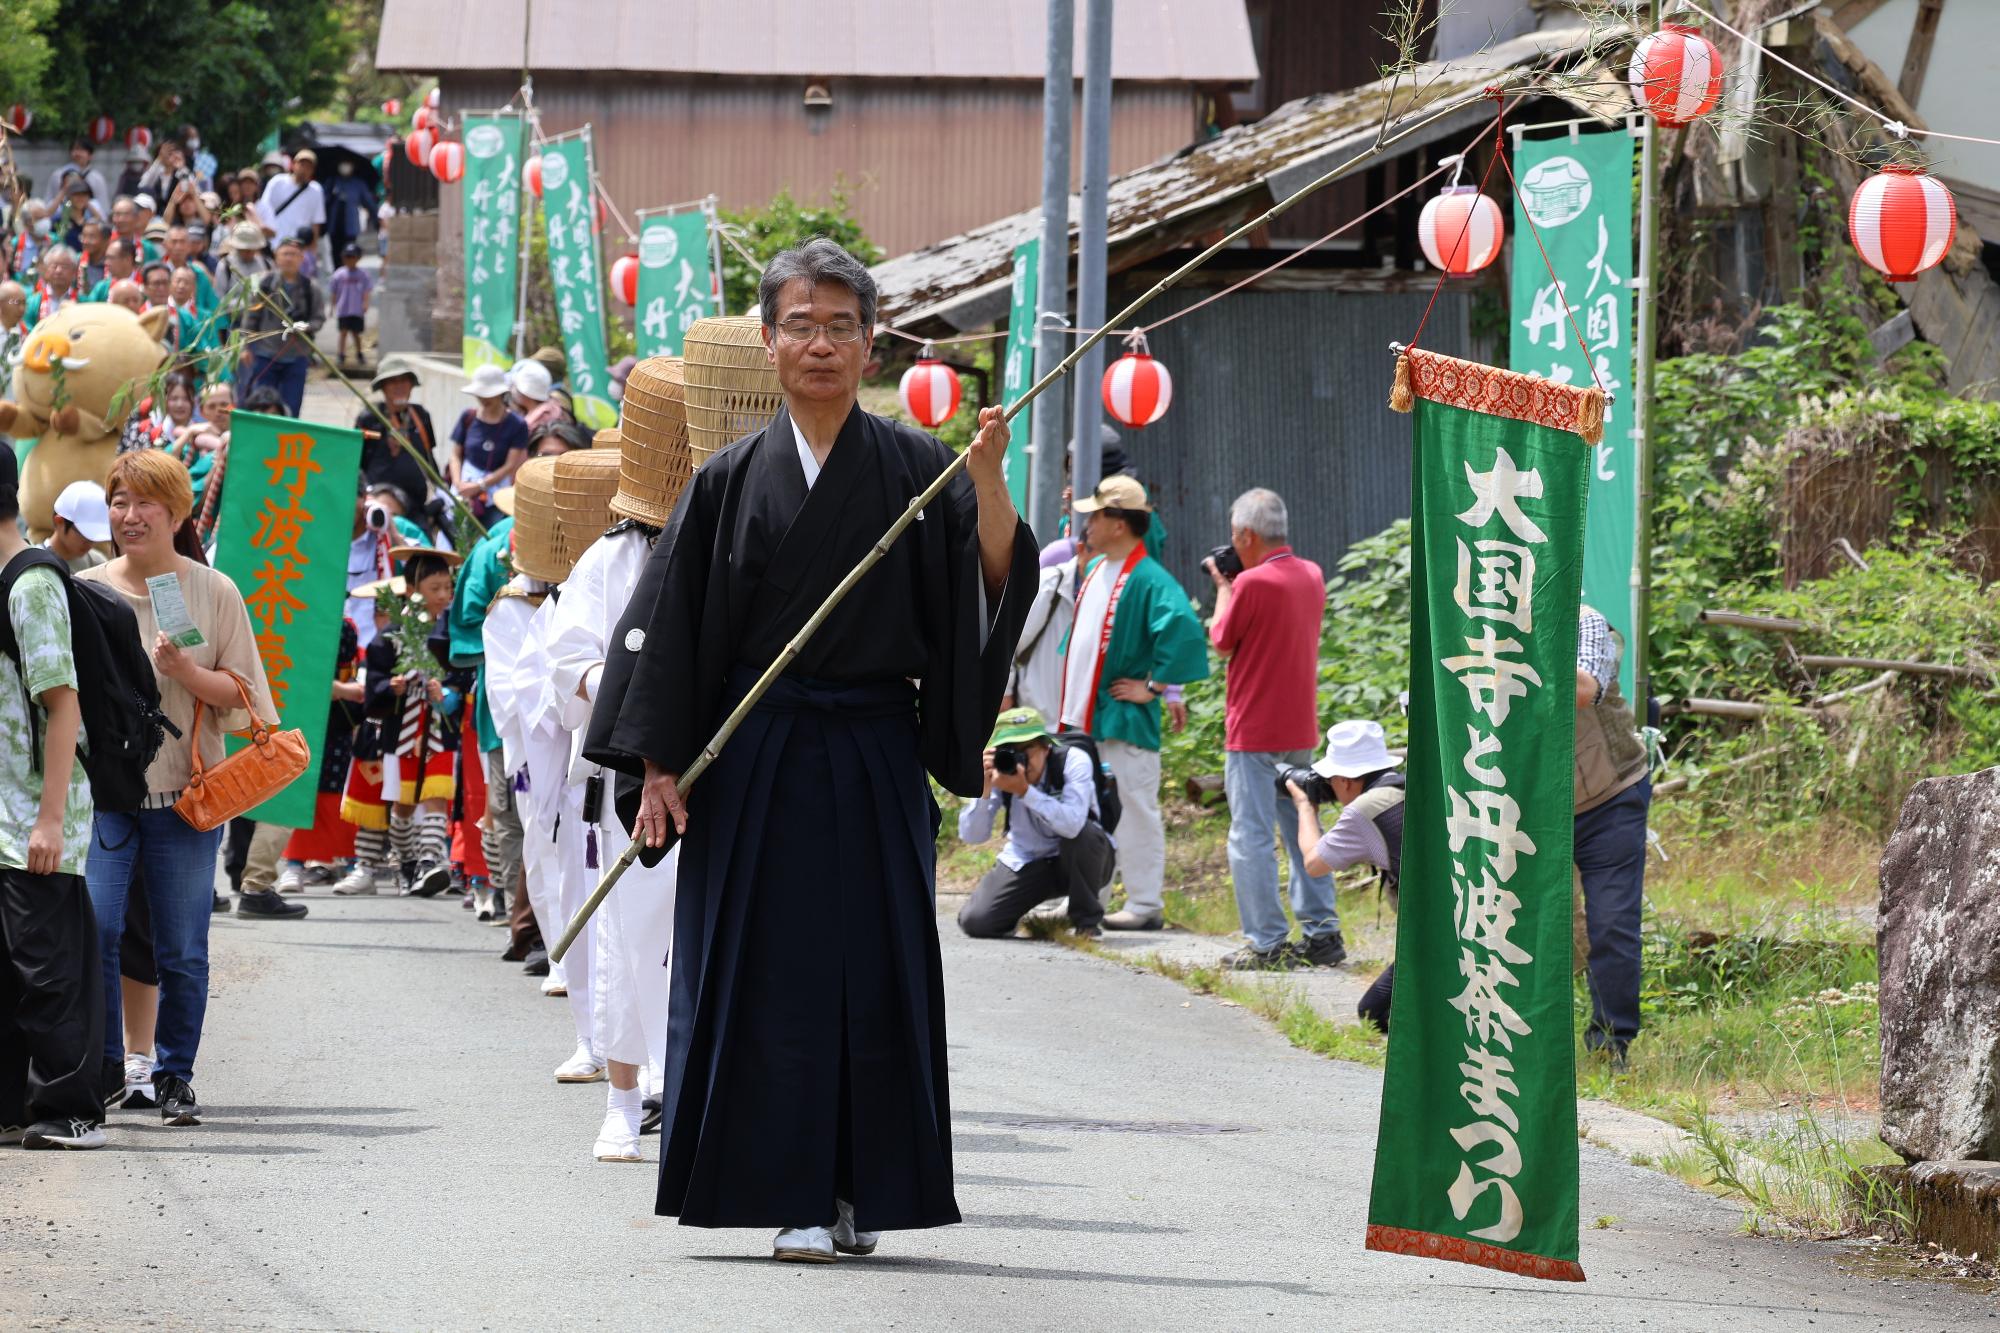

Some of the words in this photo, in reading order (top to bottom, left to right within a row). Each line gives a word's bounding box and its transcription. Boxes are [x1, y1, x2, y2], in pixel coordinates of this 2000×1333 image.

[566, 179, 597, 312] 大国寺と
[1440, 446, 1549, 1243] 大国寺と丹波茶まつり
